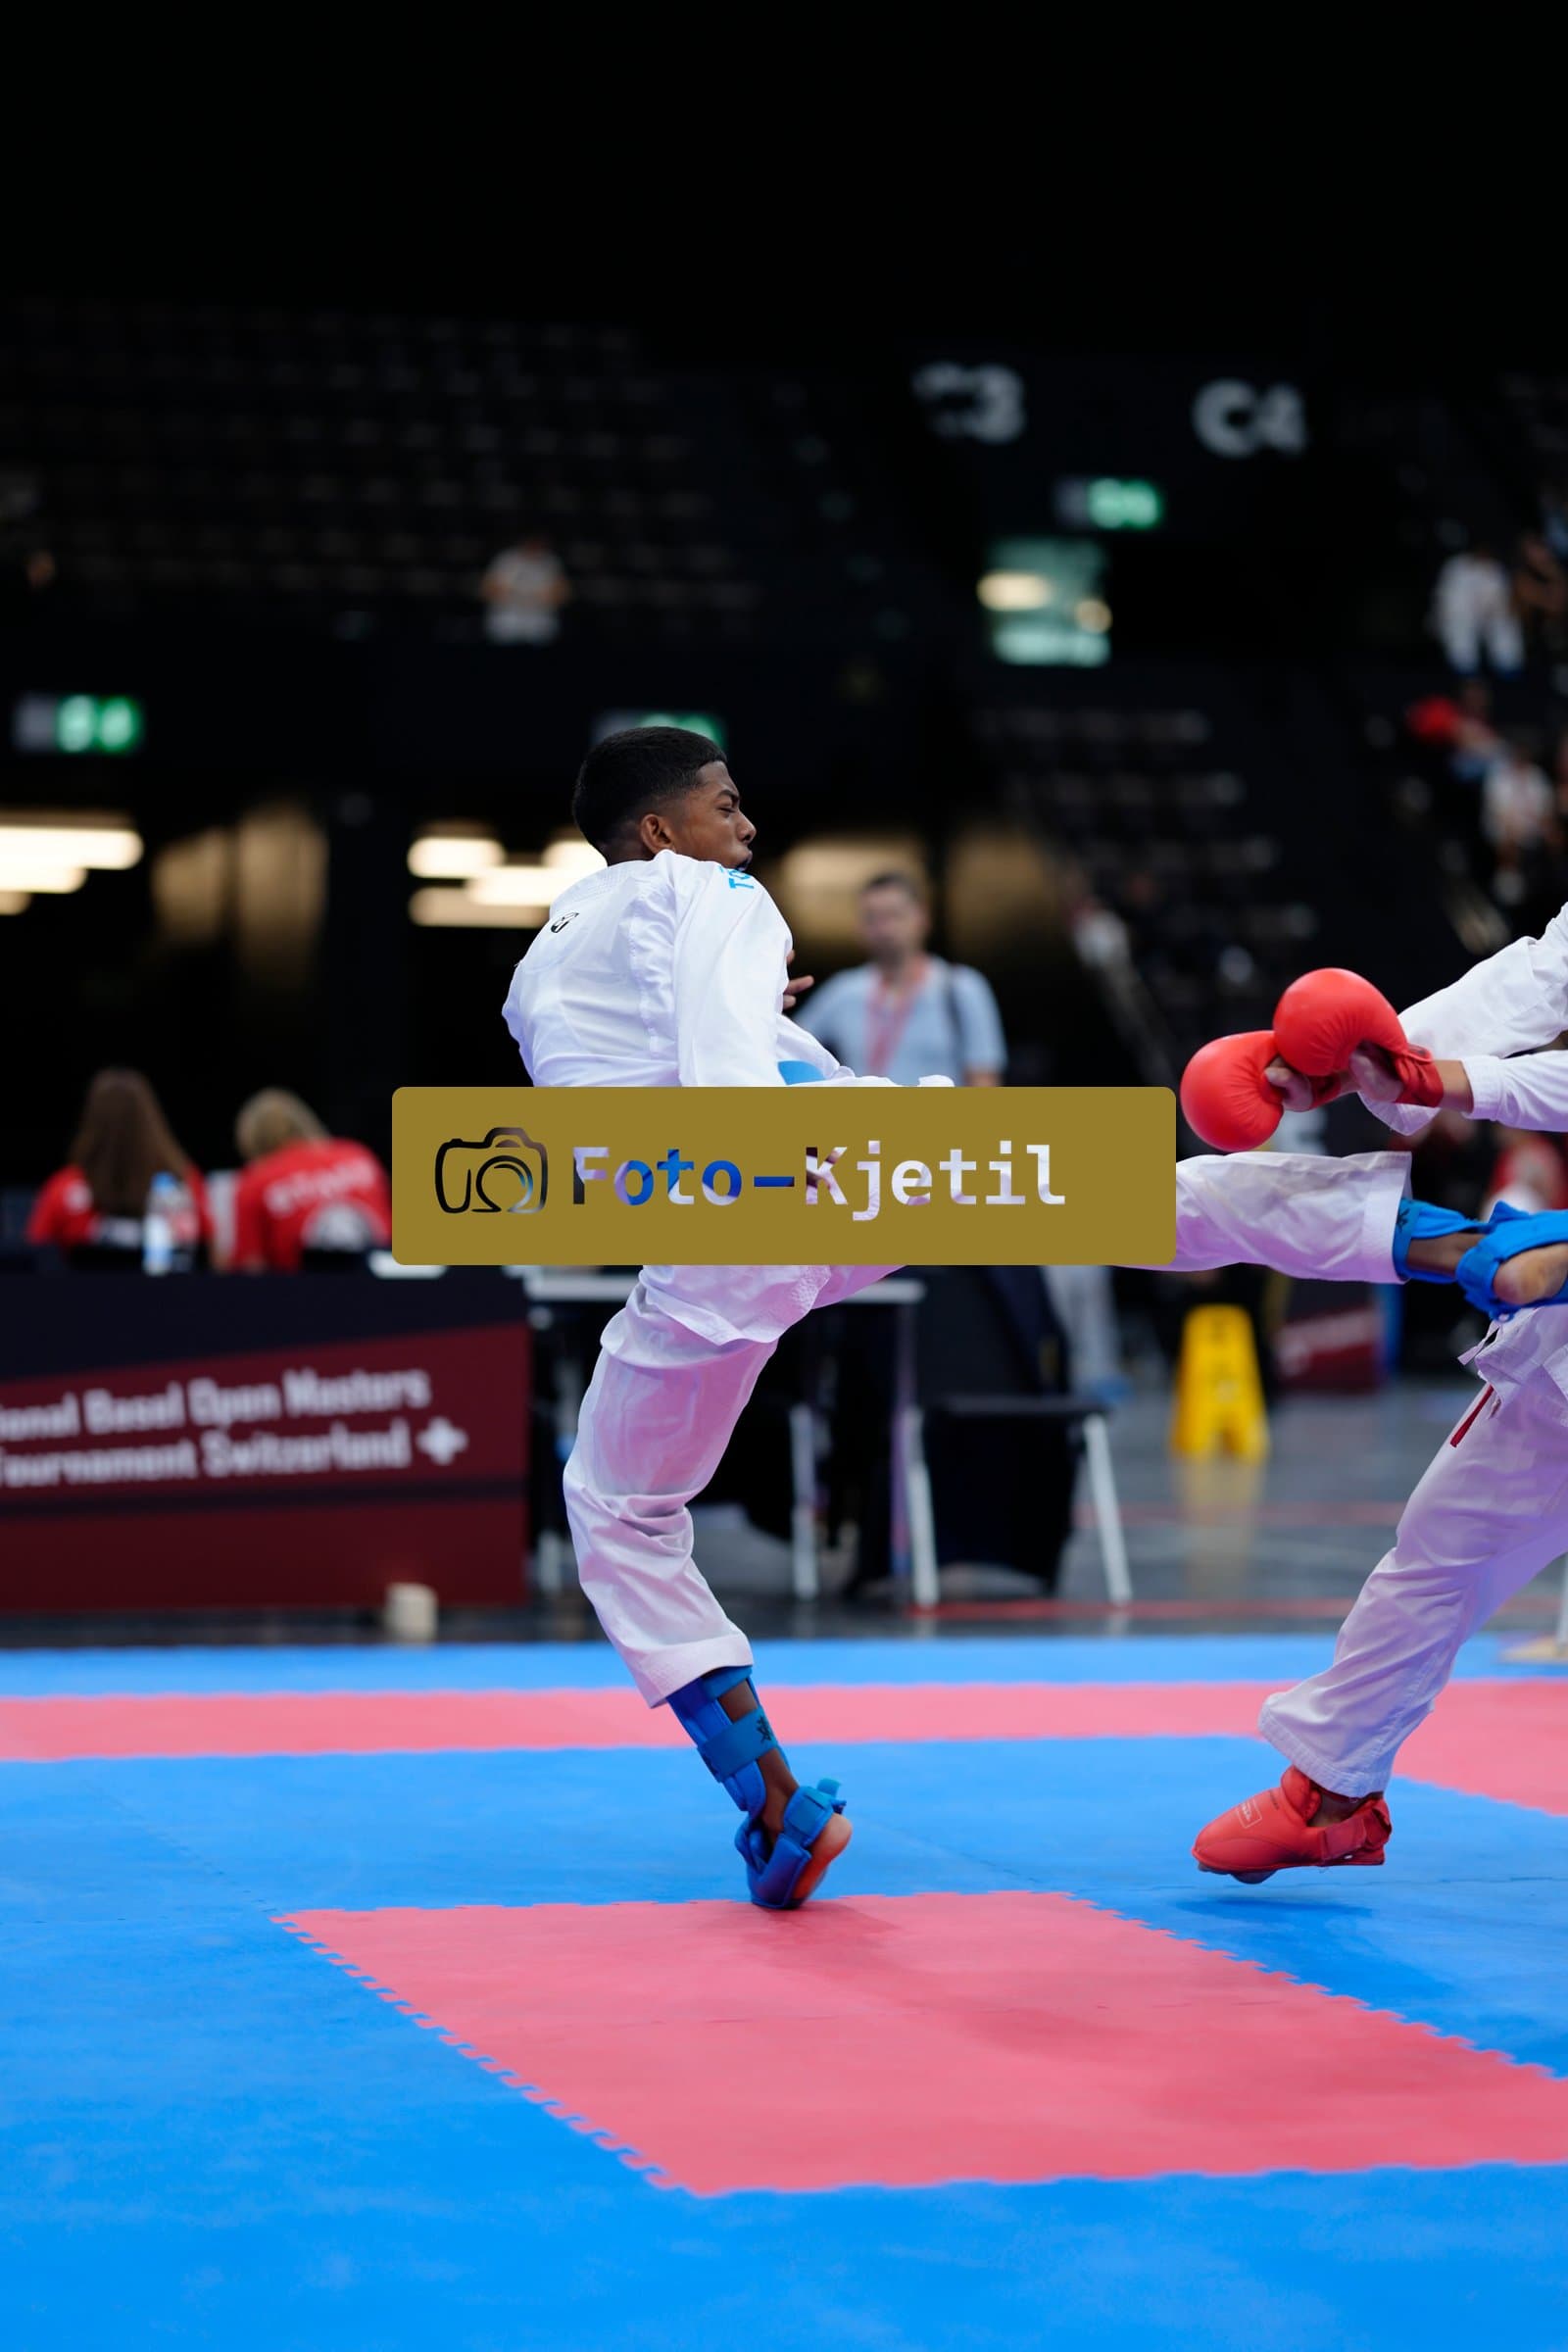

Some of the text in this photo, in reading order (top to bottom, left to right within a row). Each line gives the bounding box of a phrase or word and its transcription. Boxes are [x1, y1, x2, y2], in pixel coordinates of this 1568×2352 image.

[1194, 380, 1304, 457] C4
[0, 1367, 430, 1441] onal Basel Open Masters
[0, 1417, 412, 1488] ournament Switzerland
